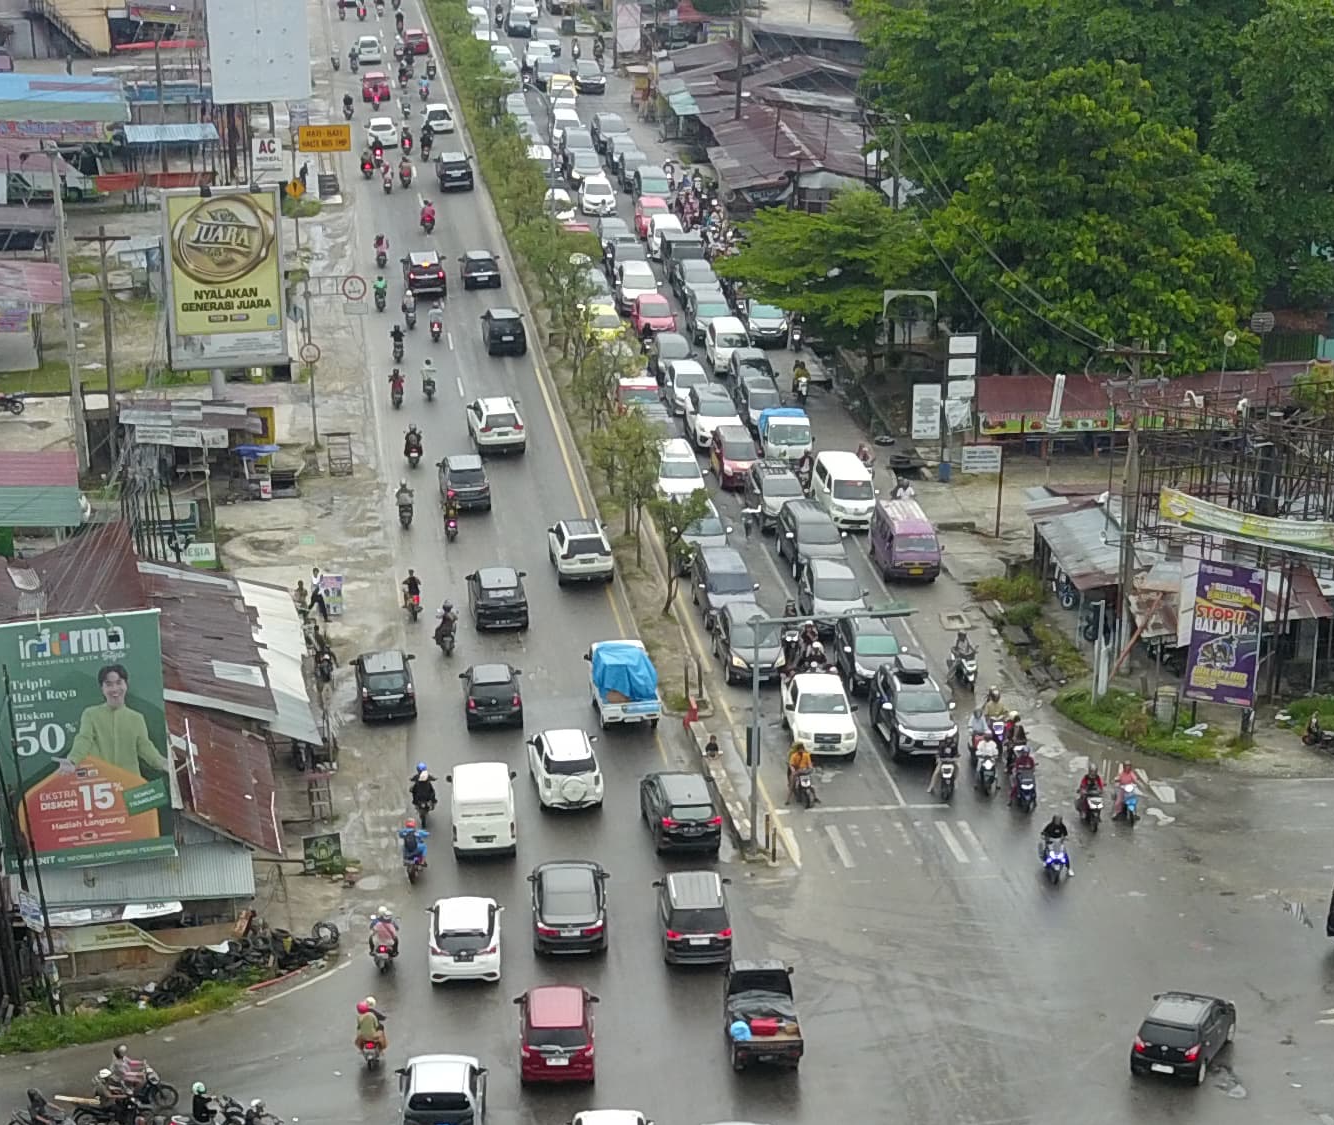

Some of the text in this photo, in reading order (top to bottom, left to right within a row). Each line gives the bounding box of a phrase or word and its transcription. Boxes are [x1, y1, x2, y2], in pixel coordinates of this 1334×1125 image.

[258, 139, 276, 155] AC
[190, 223, 249, 247] JUARA
[193, 287, 258, 300] NYALAKAN
[181, 298, 272, 312] GENERASI JUARA
[18, 626, 125, 660] informa
[11, 678, 51, 691] Triple
[11, 688, 77, 703] Hari Raya
[14, 711, 55, 721] Diskon
[39, 789, 78, 801] EKSTRA
[40, 799, 79, 812] DISKON
[51, 816, 126, 831] Hadiah Langsung
